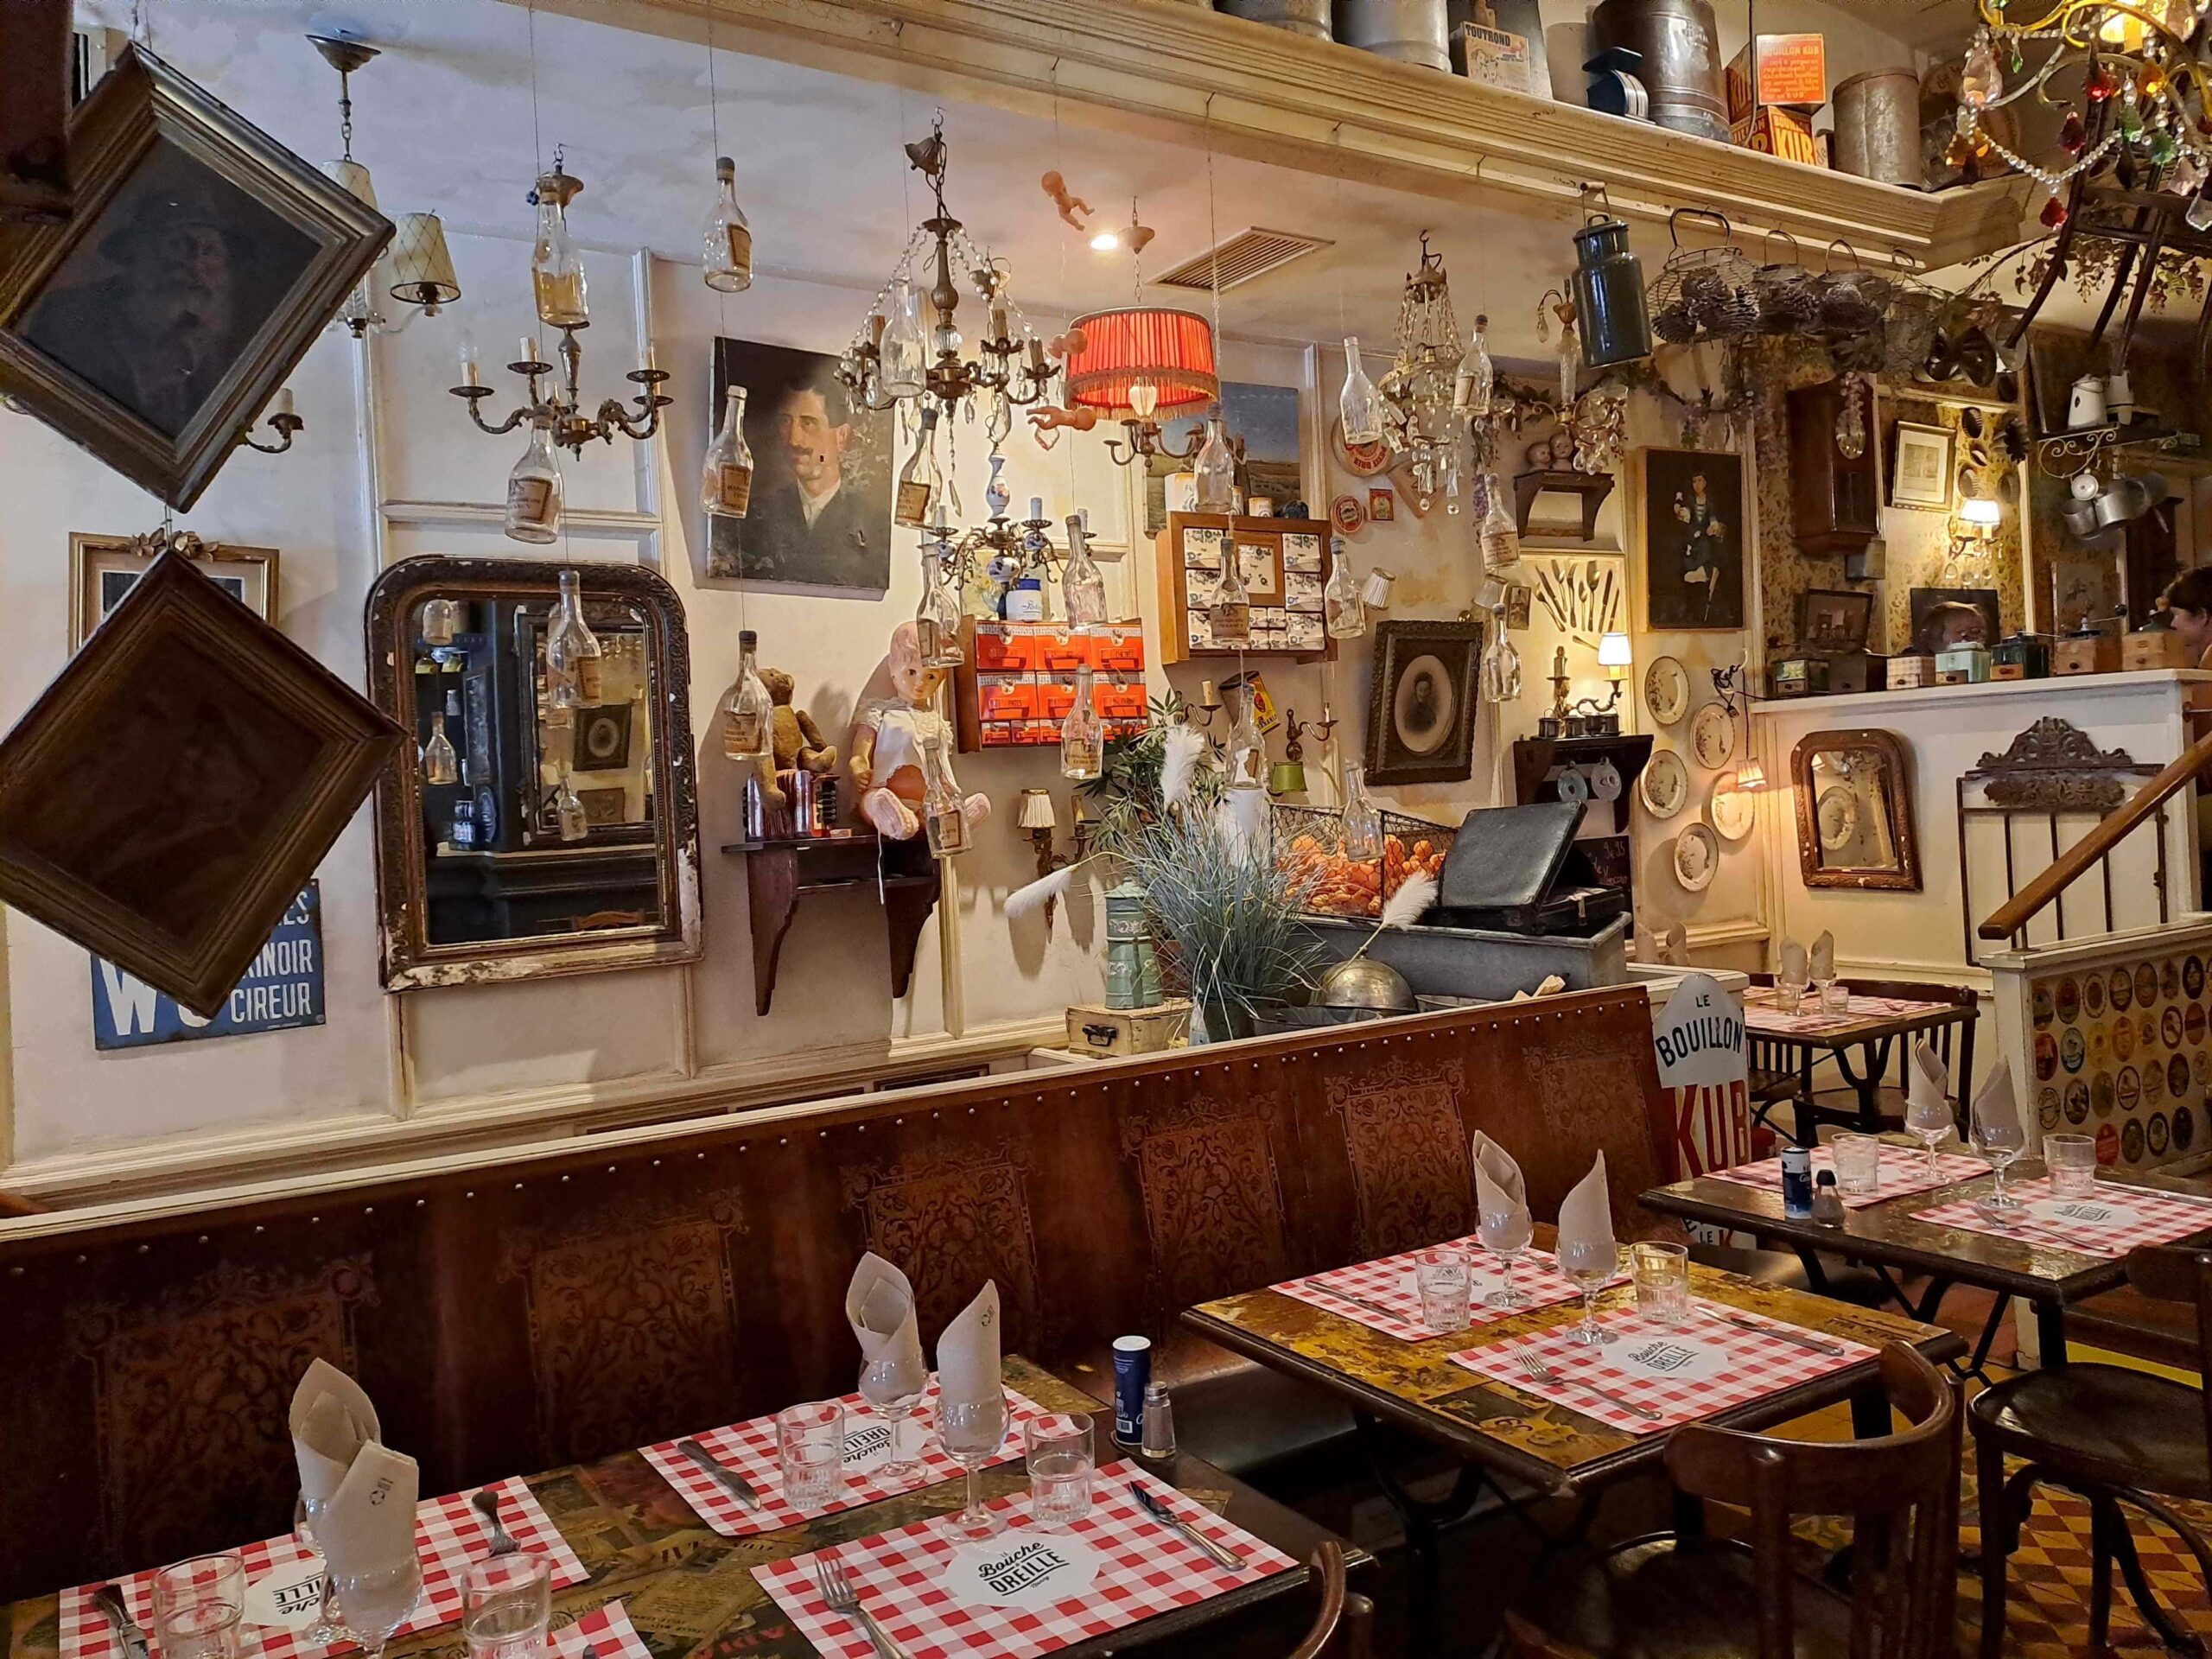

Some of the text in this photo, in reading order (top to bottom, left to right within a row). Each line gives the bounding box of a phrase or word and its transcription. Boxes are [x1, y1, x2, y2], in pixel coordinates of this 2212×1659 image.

[1465, 24, 1510, 47] TOUTROND
[230, 982, 311, 1023] CIREUR
[1696, 995, 1711, 1007] LE
[1656, 1016, 1743, 1068] BOUILLON
[1665, 1079, 1750, 1182] KUB
[978, 1541, 1045, 1578] Bouche
[988, 1551, 1065, 1593] OREILLE
